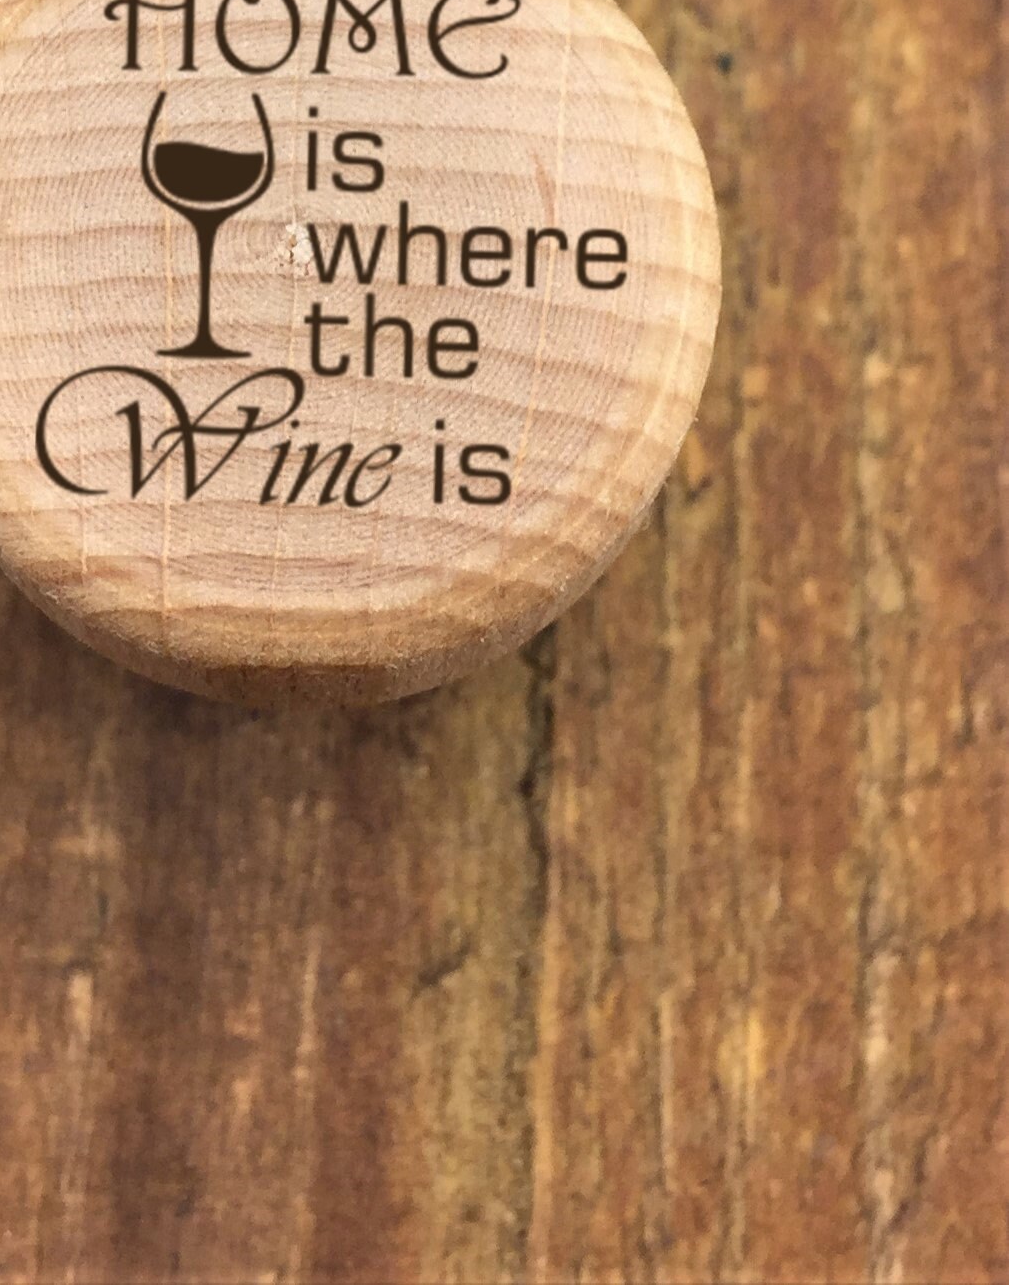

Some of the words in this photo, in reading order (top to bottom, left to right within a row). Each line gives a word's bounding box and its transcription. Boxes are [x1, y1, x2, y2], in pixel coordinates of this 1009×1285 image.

[306, 106, 386, 193] is
[306, 201, 629, 290] where
[304, 292, 480, 380] the
[35, 365, 402, 508] Wine
[432, 419, 512, 506] is
